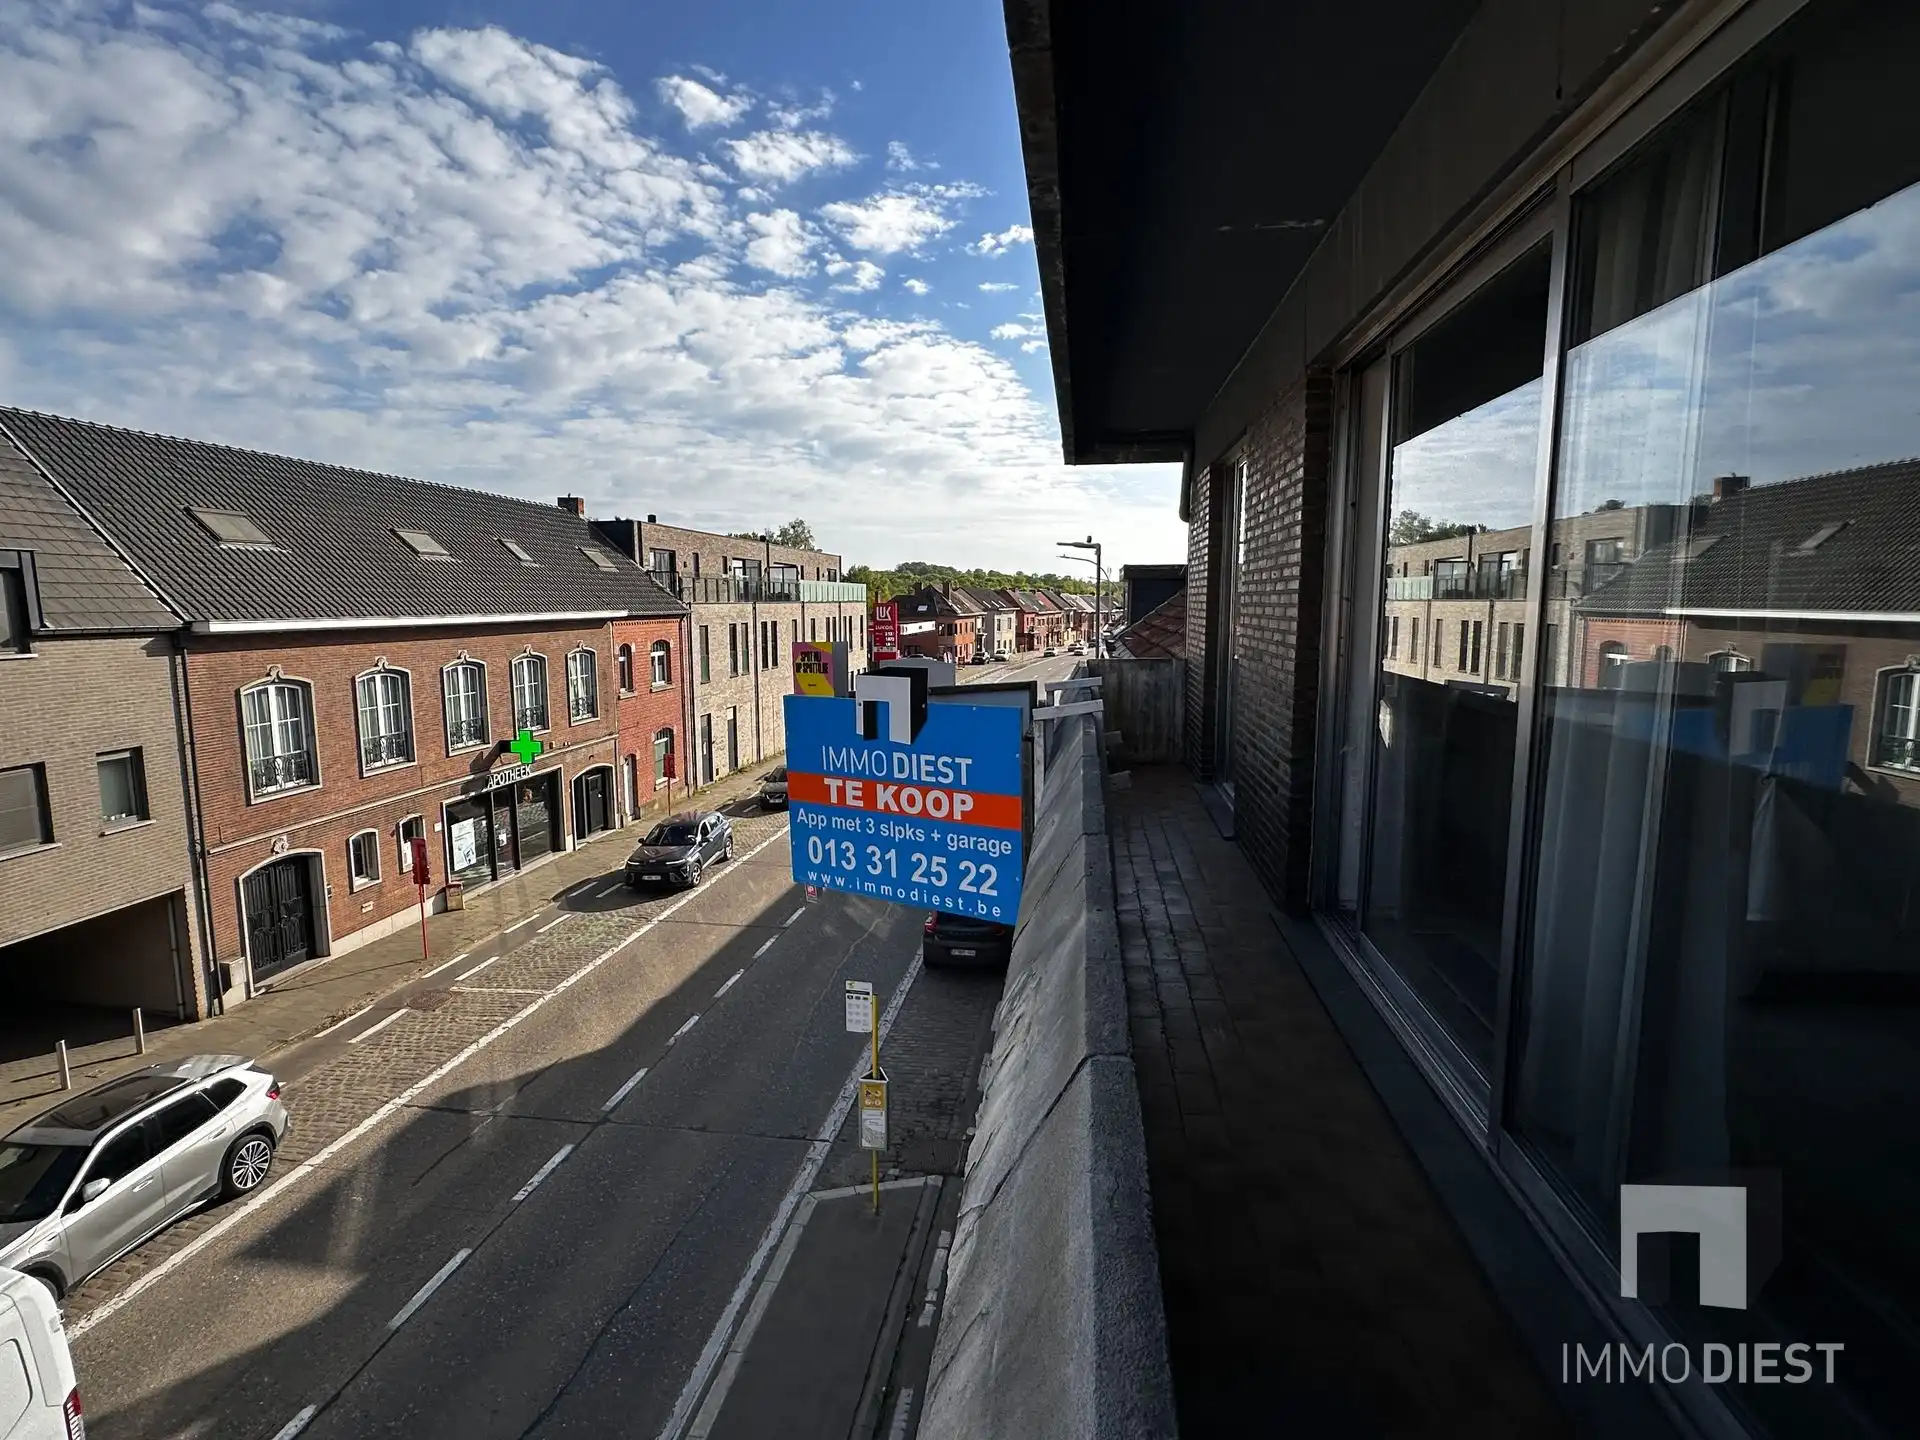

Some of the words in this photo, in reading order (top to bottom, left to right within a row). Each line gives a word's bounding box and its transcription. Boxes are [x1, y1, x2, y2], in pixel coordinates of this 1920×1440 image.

[487, 764, 531, 789] APOTHEEK
[821, 745, 887, 778] IMMO
[892, 752, 972, 786] DIEST
[824, 777, 865, 808] TE
[876, 784, 974, 821] KOOP
[796, 808, 827, 830] App
[831, 815, 861, 832] met
[866, 818, 875, 834] 3
[880, 820, 925, 843] slpks
[947, 834, 1012, 858] garage
[807, 836, 857, 871] 013
[866, 845, 898, 878] 31
[911, 853, 948, 888] 25
[959, 861, 999, 897] 22
[807, 871, 1001, 917] www.immodiest.be
